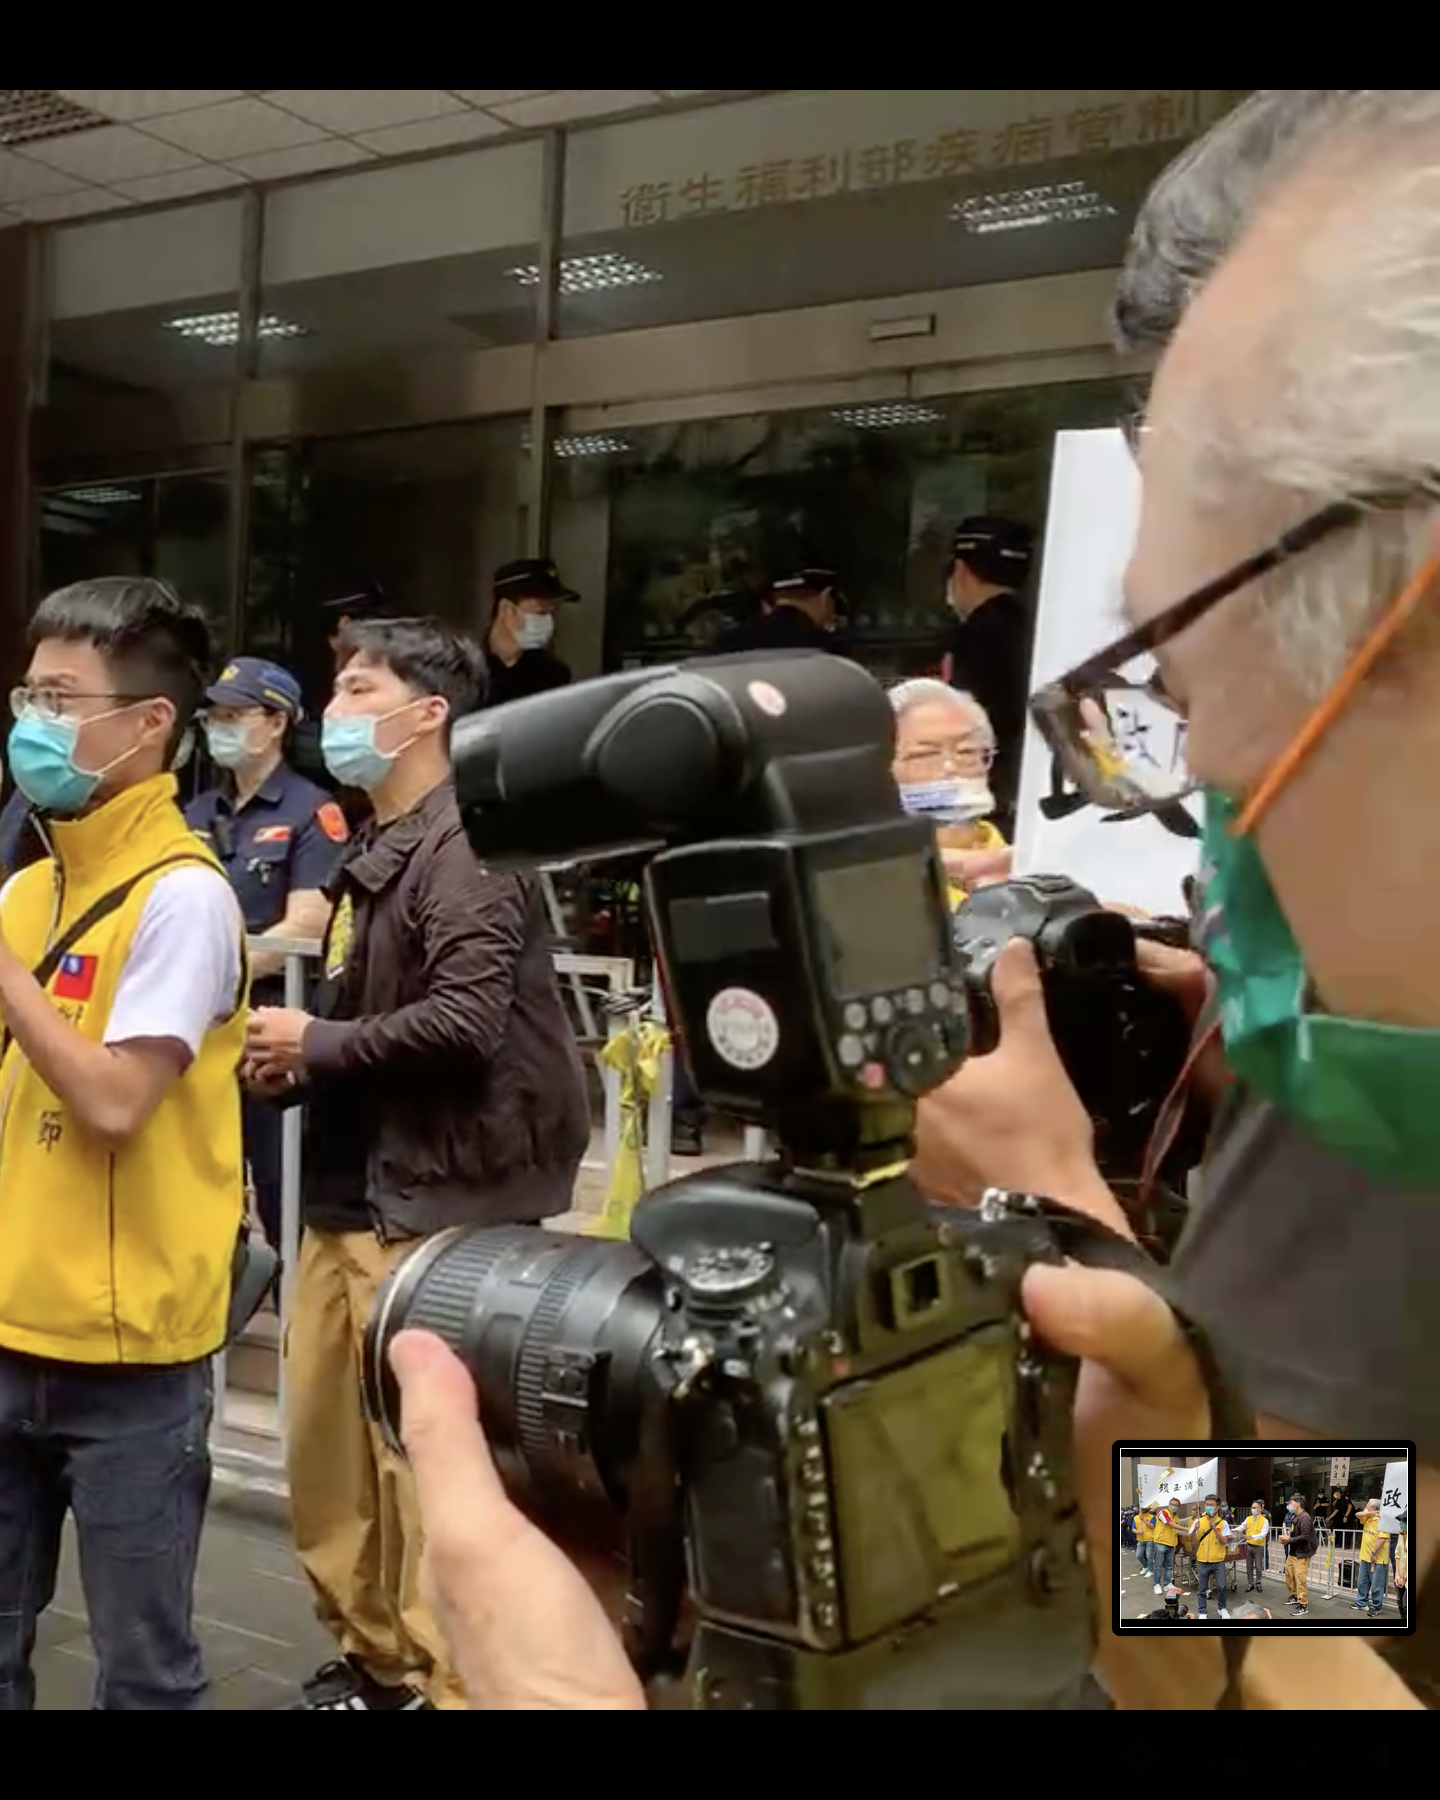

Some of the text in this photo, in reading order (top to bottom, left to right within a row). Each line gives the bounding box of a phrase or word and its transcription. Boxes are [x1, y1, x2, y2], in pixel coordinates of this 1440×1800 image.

[619, 89, 1240, 230] 衛生福利部疾病管制
